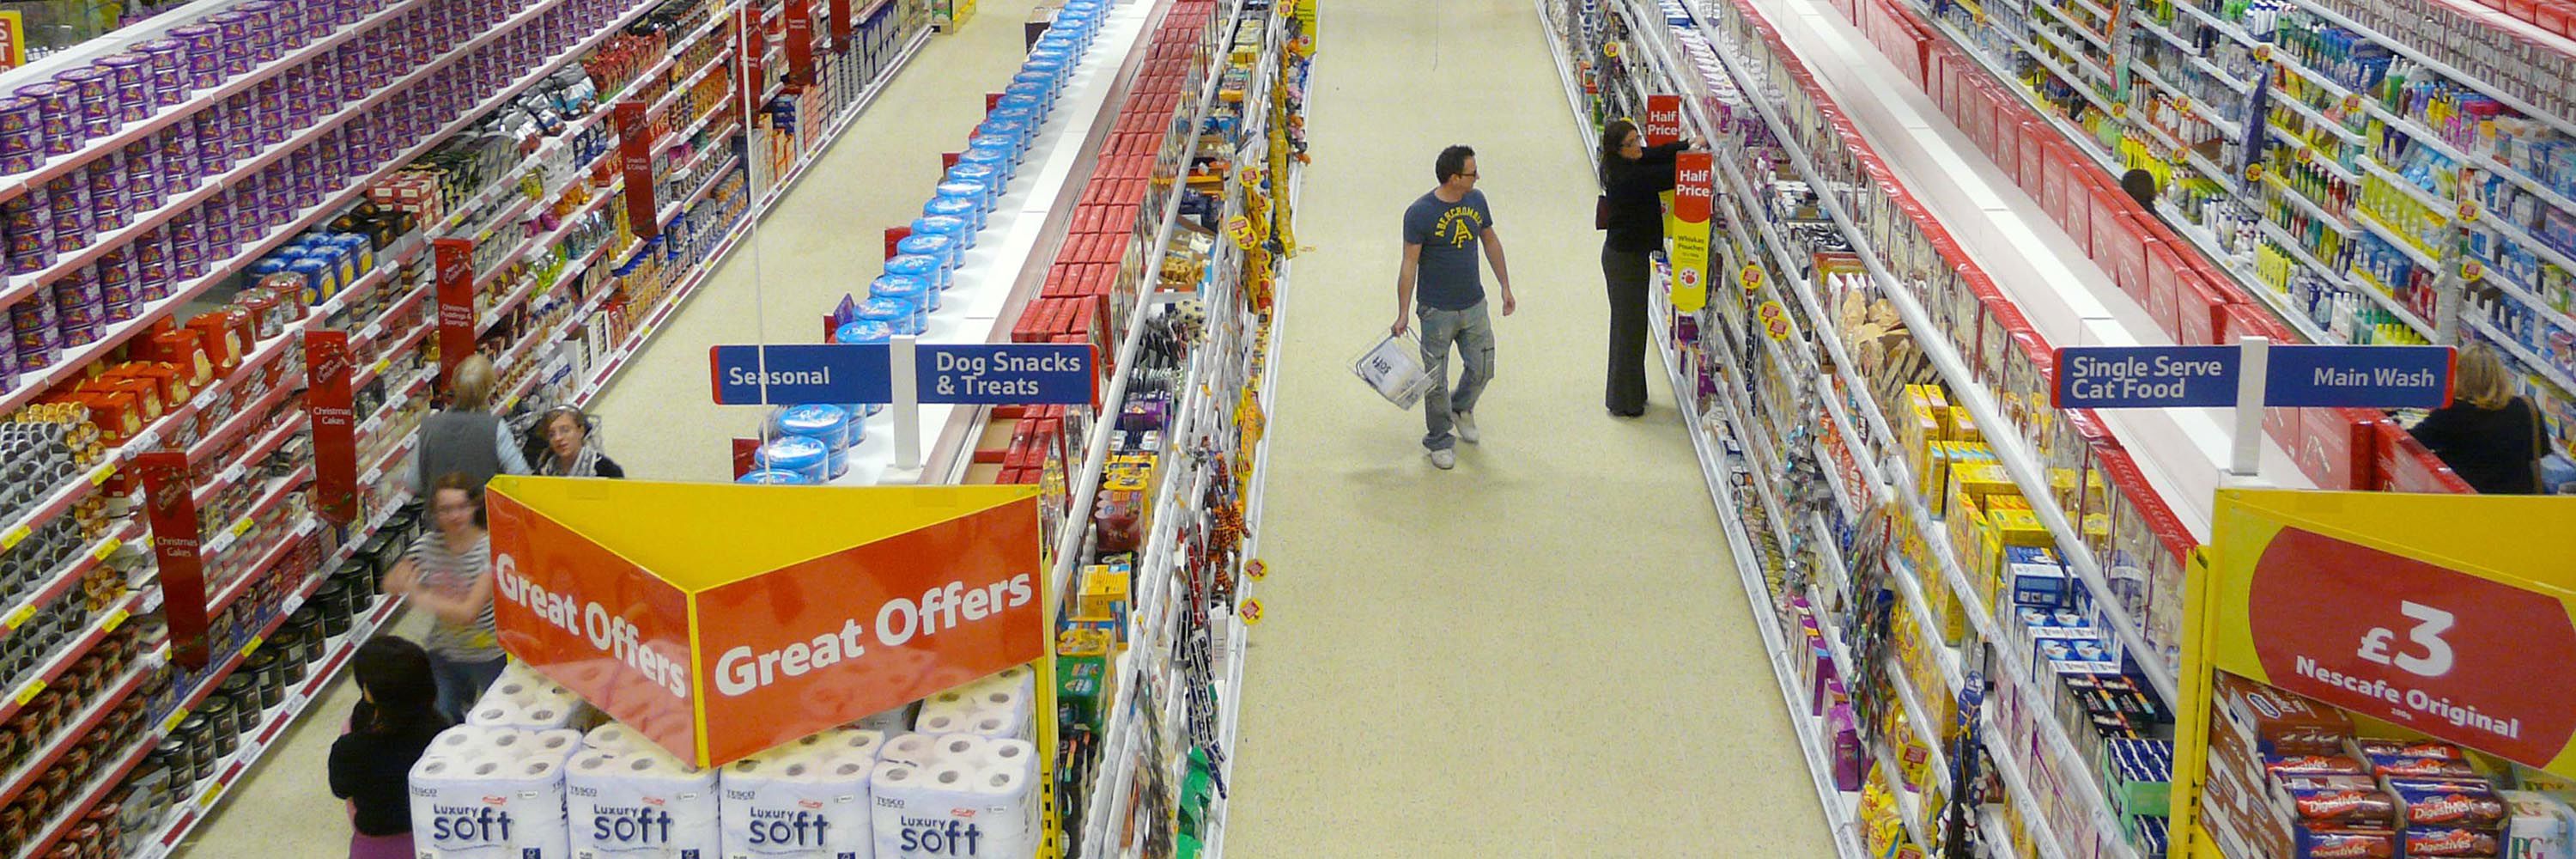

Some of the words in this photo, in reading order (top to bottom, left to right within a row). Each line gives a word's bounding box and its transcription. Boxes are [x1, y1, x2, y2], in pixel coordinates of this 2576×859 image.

[1650, 111, 1677, 122] Half
[1648, 124, 1678, 136] Price
[1680, 170, 1710, 182] Half
[1677, 184, 1710, 197] Price
[936, 351, 987, 376] Dog
[993, 350, 1081, 372] Snacks
[2072, 356, 2148, 381] Single
[2154, 356, 2222, 376] Serve
[729, 366, 830, 386] Seasonal
[936, 375, 955, 395] &
[961, 375, 1040, 395] Treats
[2313, 367, 2369, 386] Main
[2374, 368, 2435, 387] Wash
[2071, 379, 2115, 399] Cat
[2122, 378, 2186, 399] Food
[313, 406, 352, 416] Christmas
[322, 416, 345, 424] Cakes
[156, 536, 198, 546] Christmas
[167, 547, 191, 557] Cakes
[496, 553, 580, 636] Great
[585, 601, 686, 698] Offers
[714, 618, 865, 696] Great
[875, 573, 1032, 646] Offers
[2357, 600, 2454, 677] £3
[2295, 655, 2401, 704] Nescafe
[2406, 689, 2519, 740] Original
[2391, 708, 2412, 721] 200g
[726, 789, 756, 799] TESCO
[877, 796, 905, 806] TESCO
[434, 804, 478, 817] Luxury
[594, 804, 639, 817] Luxury
[750, 806, 795, 820] Luxury
[2310, 795, 2364, 813] Digestives
[2414, 801, 2470, 819] Digestives
[433, 807, 513, 841] soft
[593, 807, 672, 843] soft
[749, 811, 830, 846] soft
[901, 815, 946, 830] Luxury
[900, 820, 981, 856] soft
